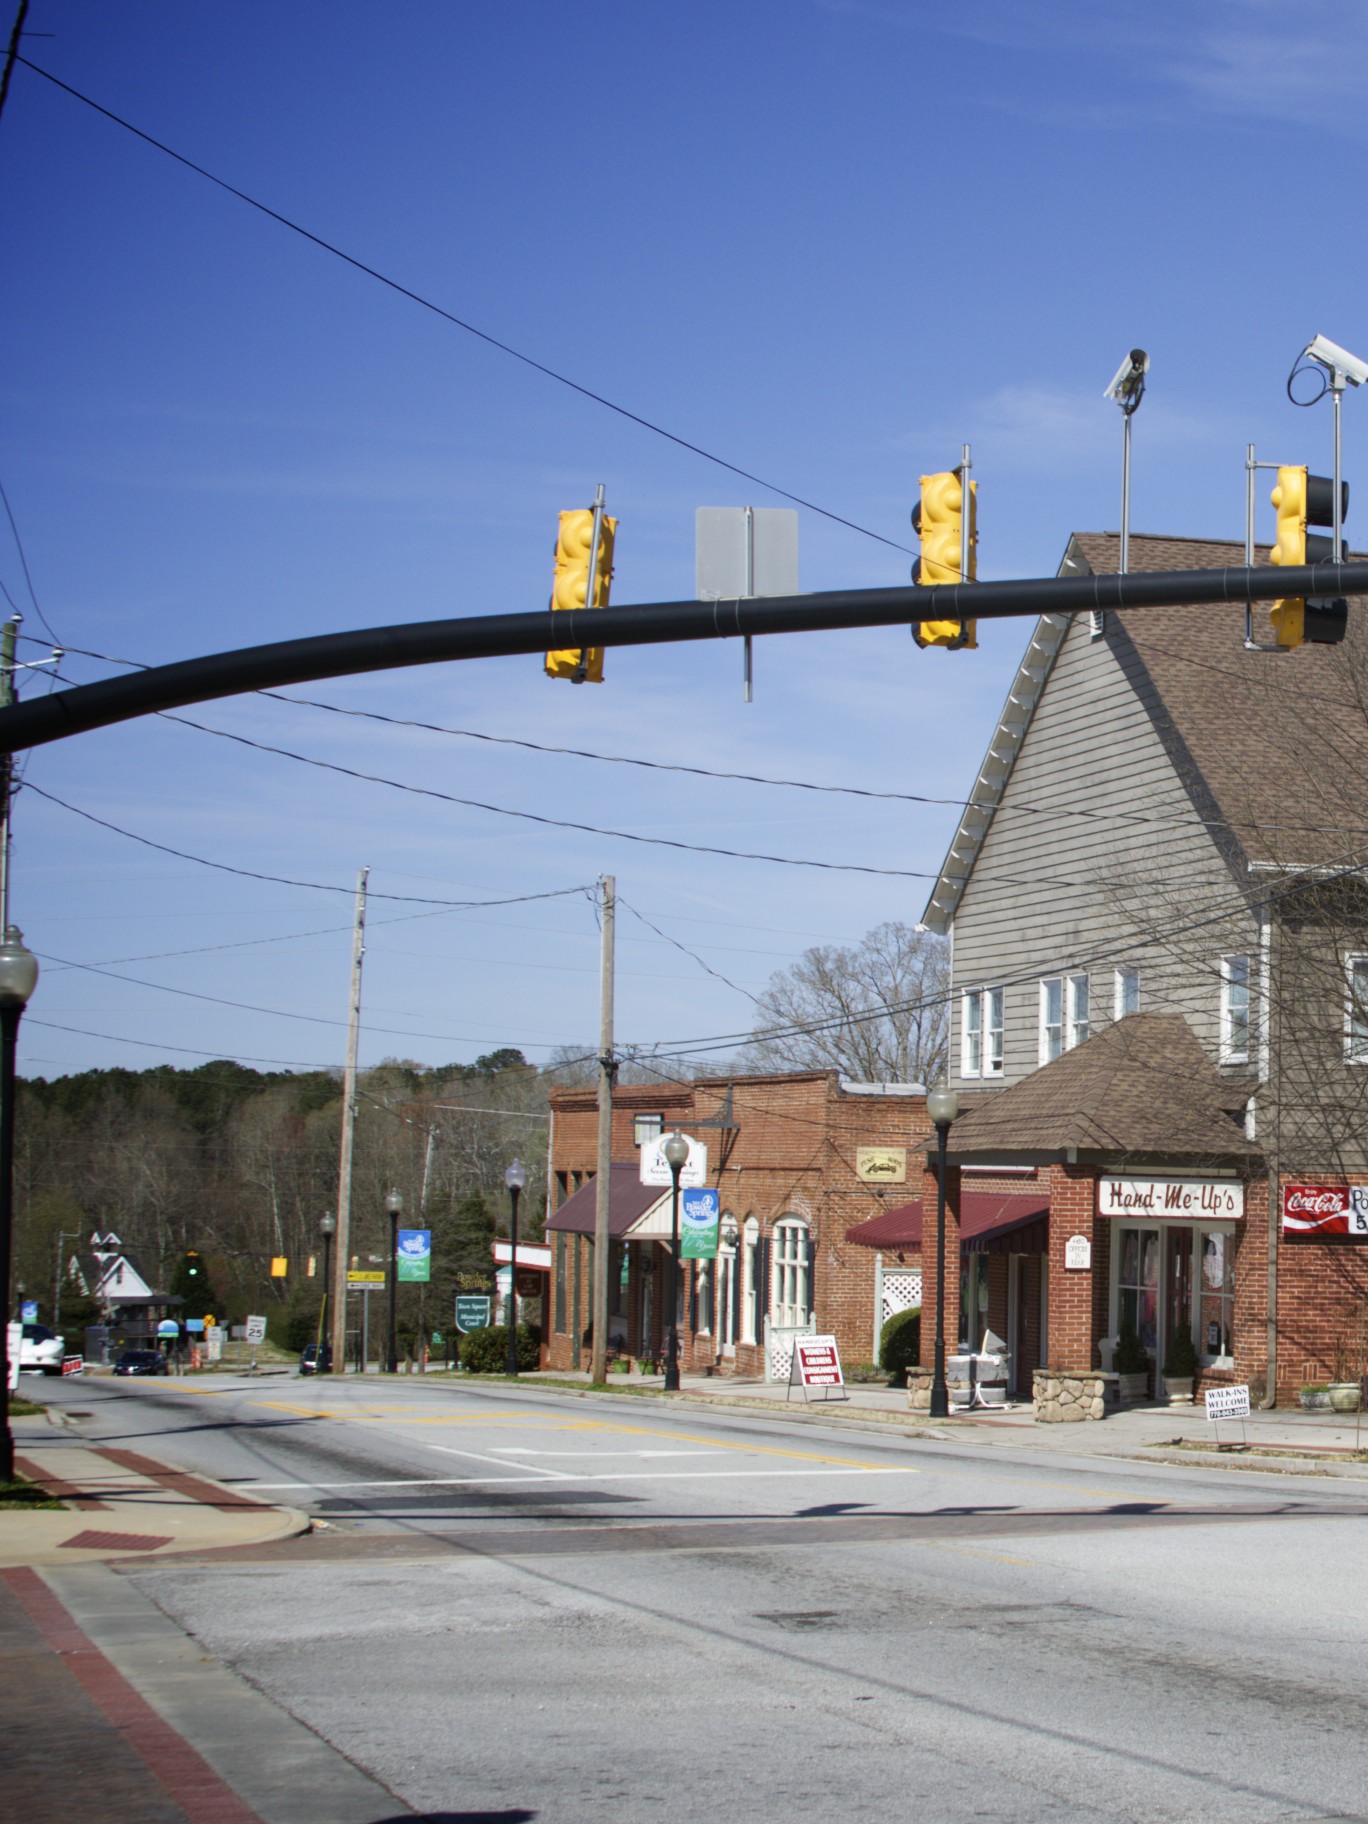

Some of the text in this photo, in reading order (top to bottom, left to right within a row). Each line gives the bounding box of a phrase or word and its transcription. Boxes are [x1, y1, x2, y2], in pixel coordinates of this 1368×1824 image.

[1109, 1182, 1235, 1214] Hand-Me-Up's
[1287, 1191, 1345, 1213] Coca-Cola
[248, 1328, 263, 1338] 25
[1208, 1387, 1247, 1399] WALK-INS
[1208, 1397, 1247, 1408] WELCOME
